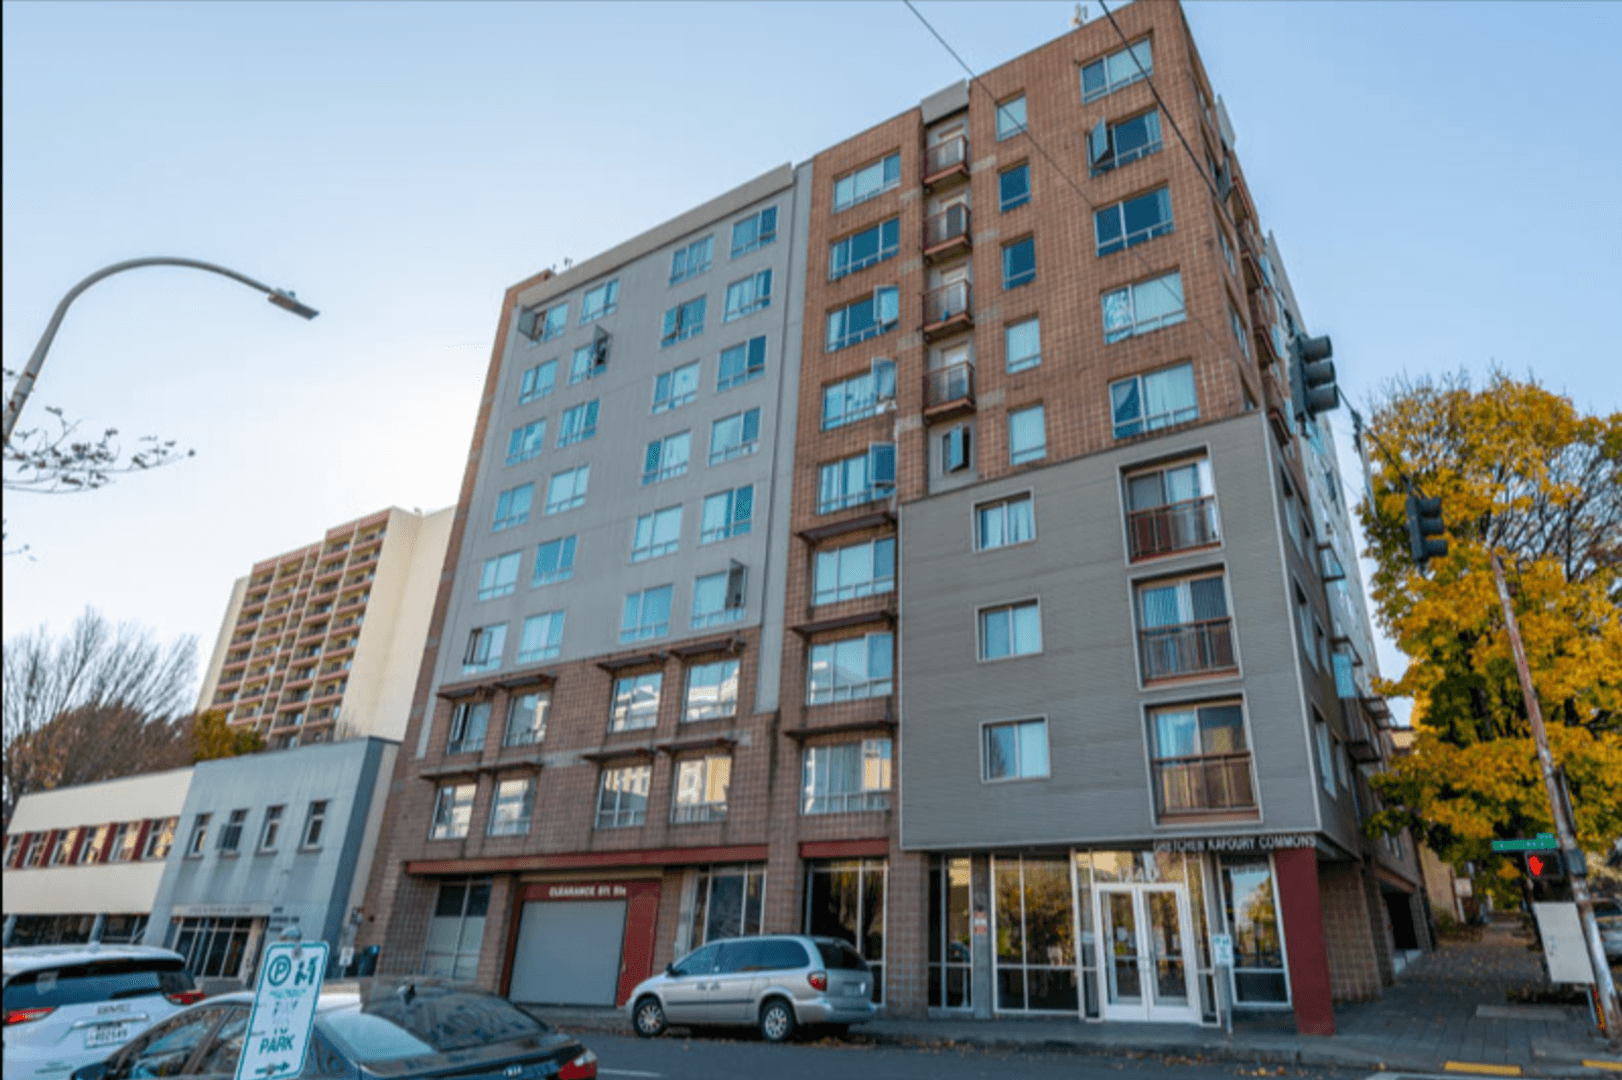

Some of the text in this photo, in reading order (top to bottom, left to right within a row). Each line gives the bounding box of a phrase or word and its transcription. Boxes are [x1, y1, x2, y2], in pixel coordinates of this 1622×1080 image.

[1208, 837, 1255, 850] KAFOURY
[1258, 835, 1317, 849] COMMONS
[259, 1034, 296, 1054] PARK
